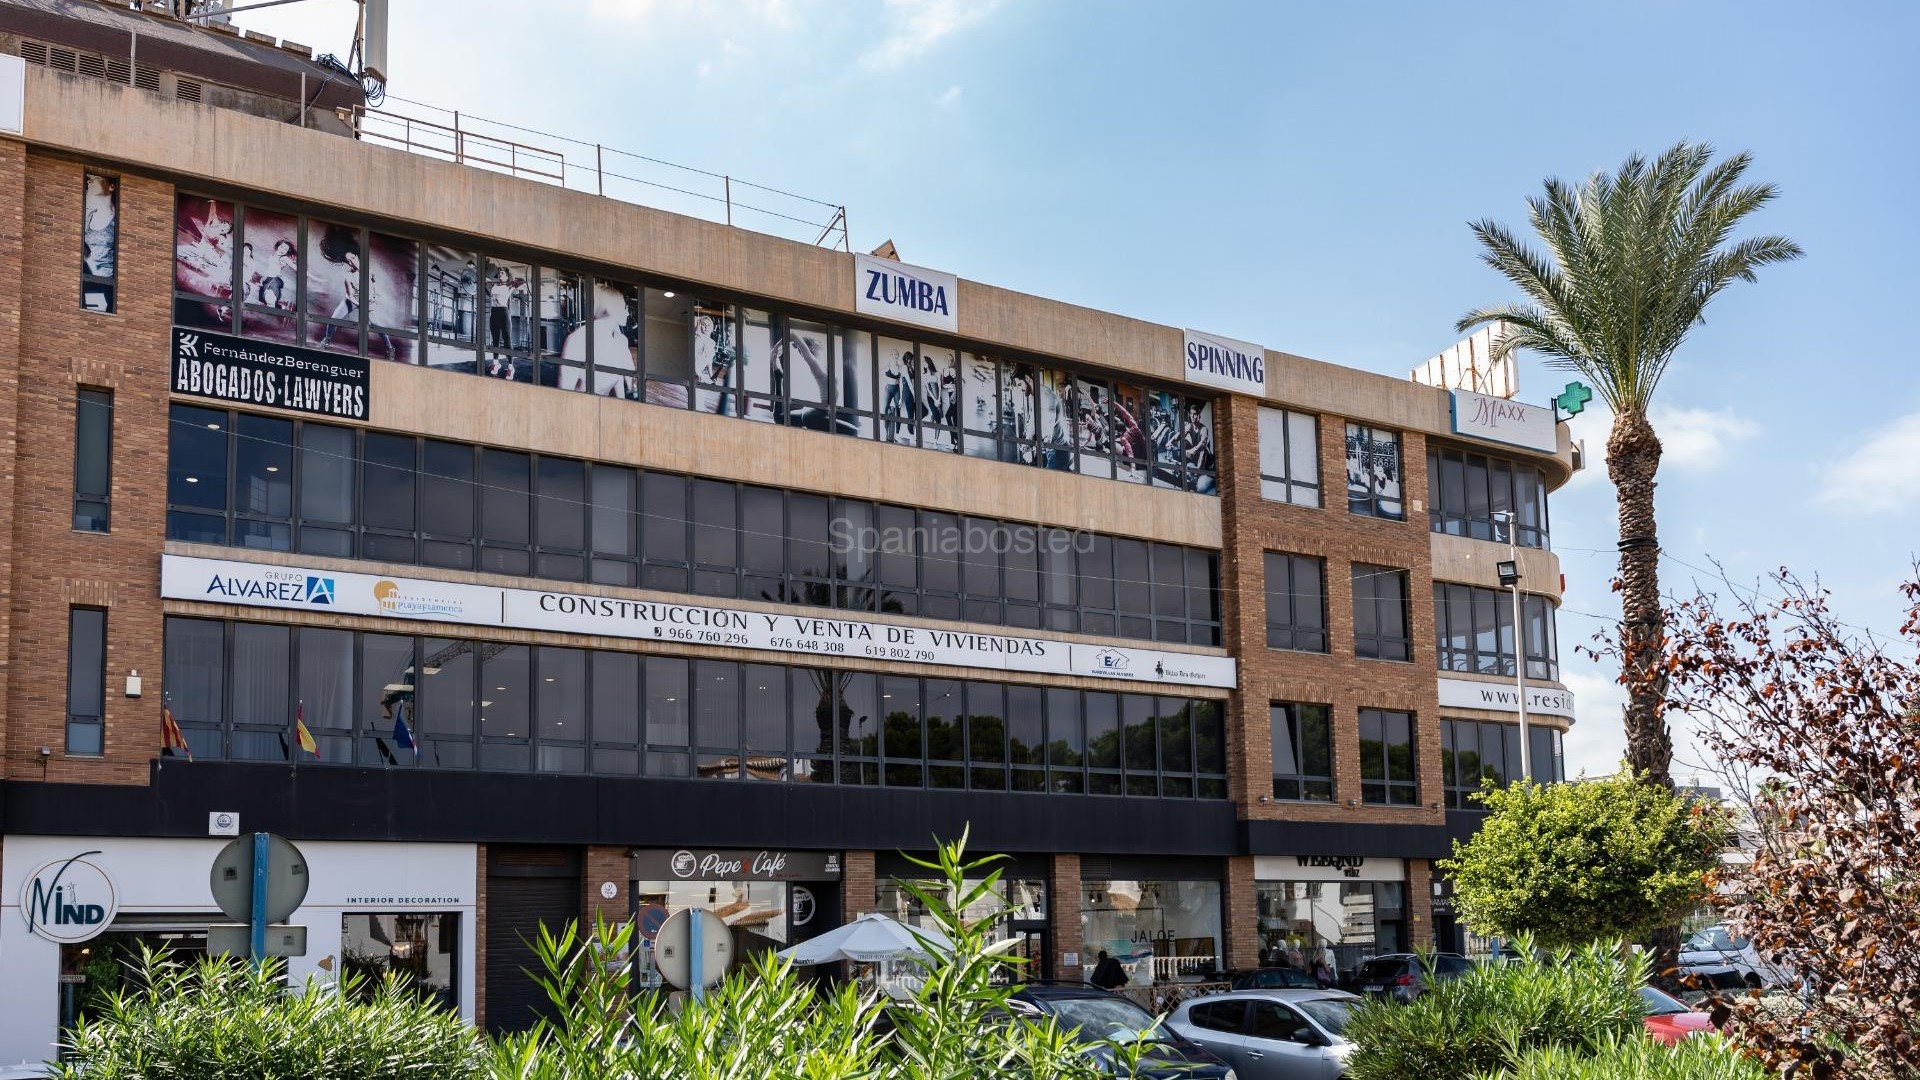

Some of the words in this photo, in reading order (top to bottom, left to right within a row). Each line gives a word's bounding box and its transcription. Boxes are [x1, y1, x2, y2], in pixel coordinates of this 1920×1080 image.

[865, 269, 949, 316] ZUMBA
[1187, 341, 1264, 384] SPINNING
[206, 574, 304, 602] ALVAREZ
[265, 571, 303, 582] GRUPO
[540, 594, 748, 630] CONSTRUCCIÓN
[763, 615, 779, 632] Y
[795, 618, 872, 640] VENTA
[887, 627, 915, 645] DE
[929, 631, 1045, 656] VIVIENDAS
[669, 628, 694, 640] 966
[697, 630, 721, 642] 760
[725, 632, 748, 645] 296
[770, 637, 793, 648] 676
[797, 638, 818, 651] 648
[823, 641, 845, 653] 308
[865, 645, 886, 656] 619
[890, 647, 910, 659] 802
[914, 649, 935, 661] 790
[1480, 689, 1574, 710] ww.resid
[752, 851, 787, 878] Café
